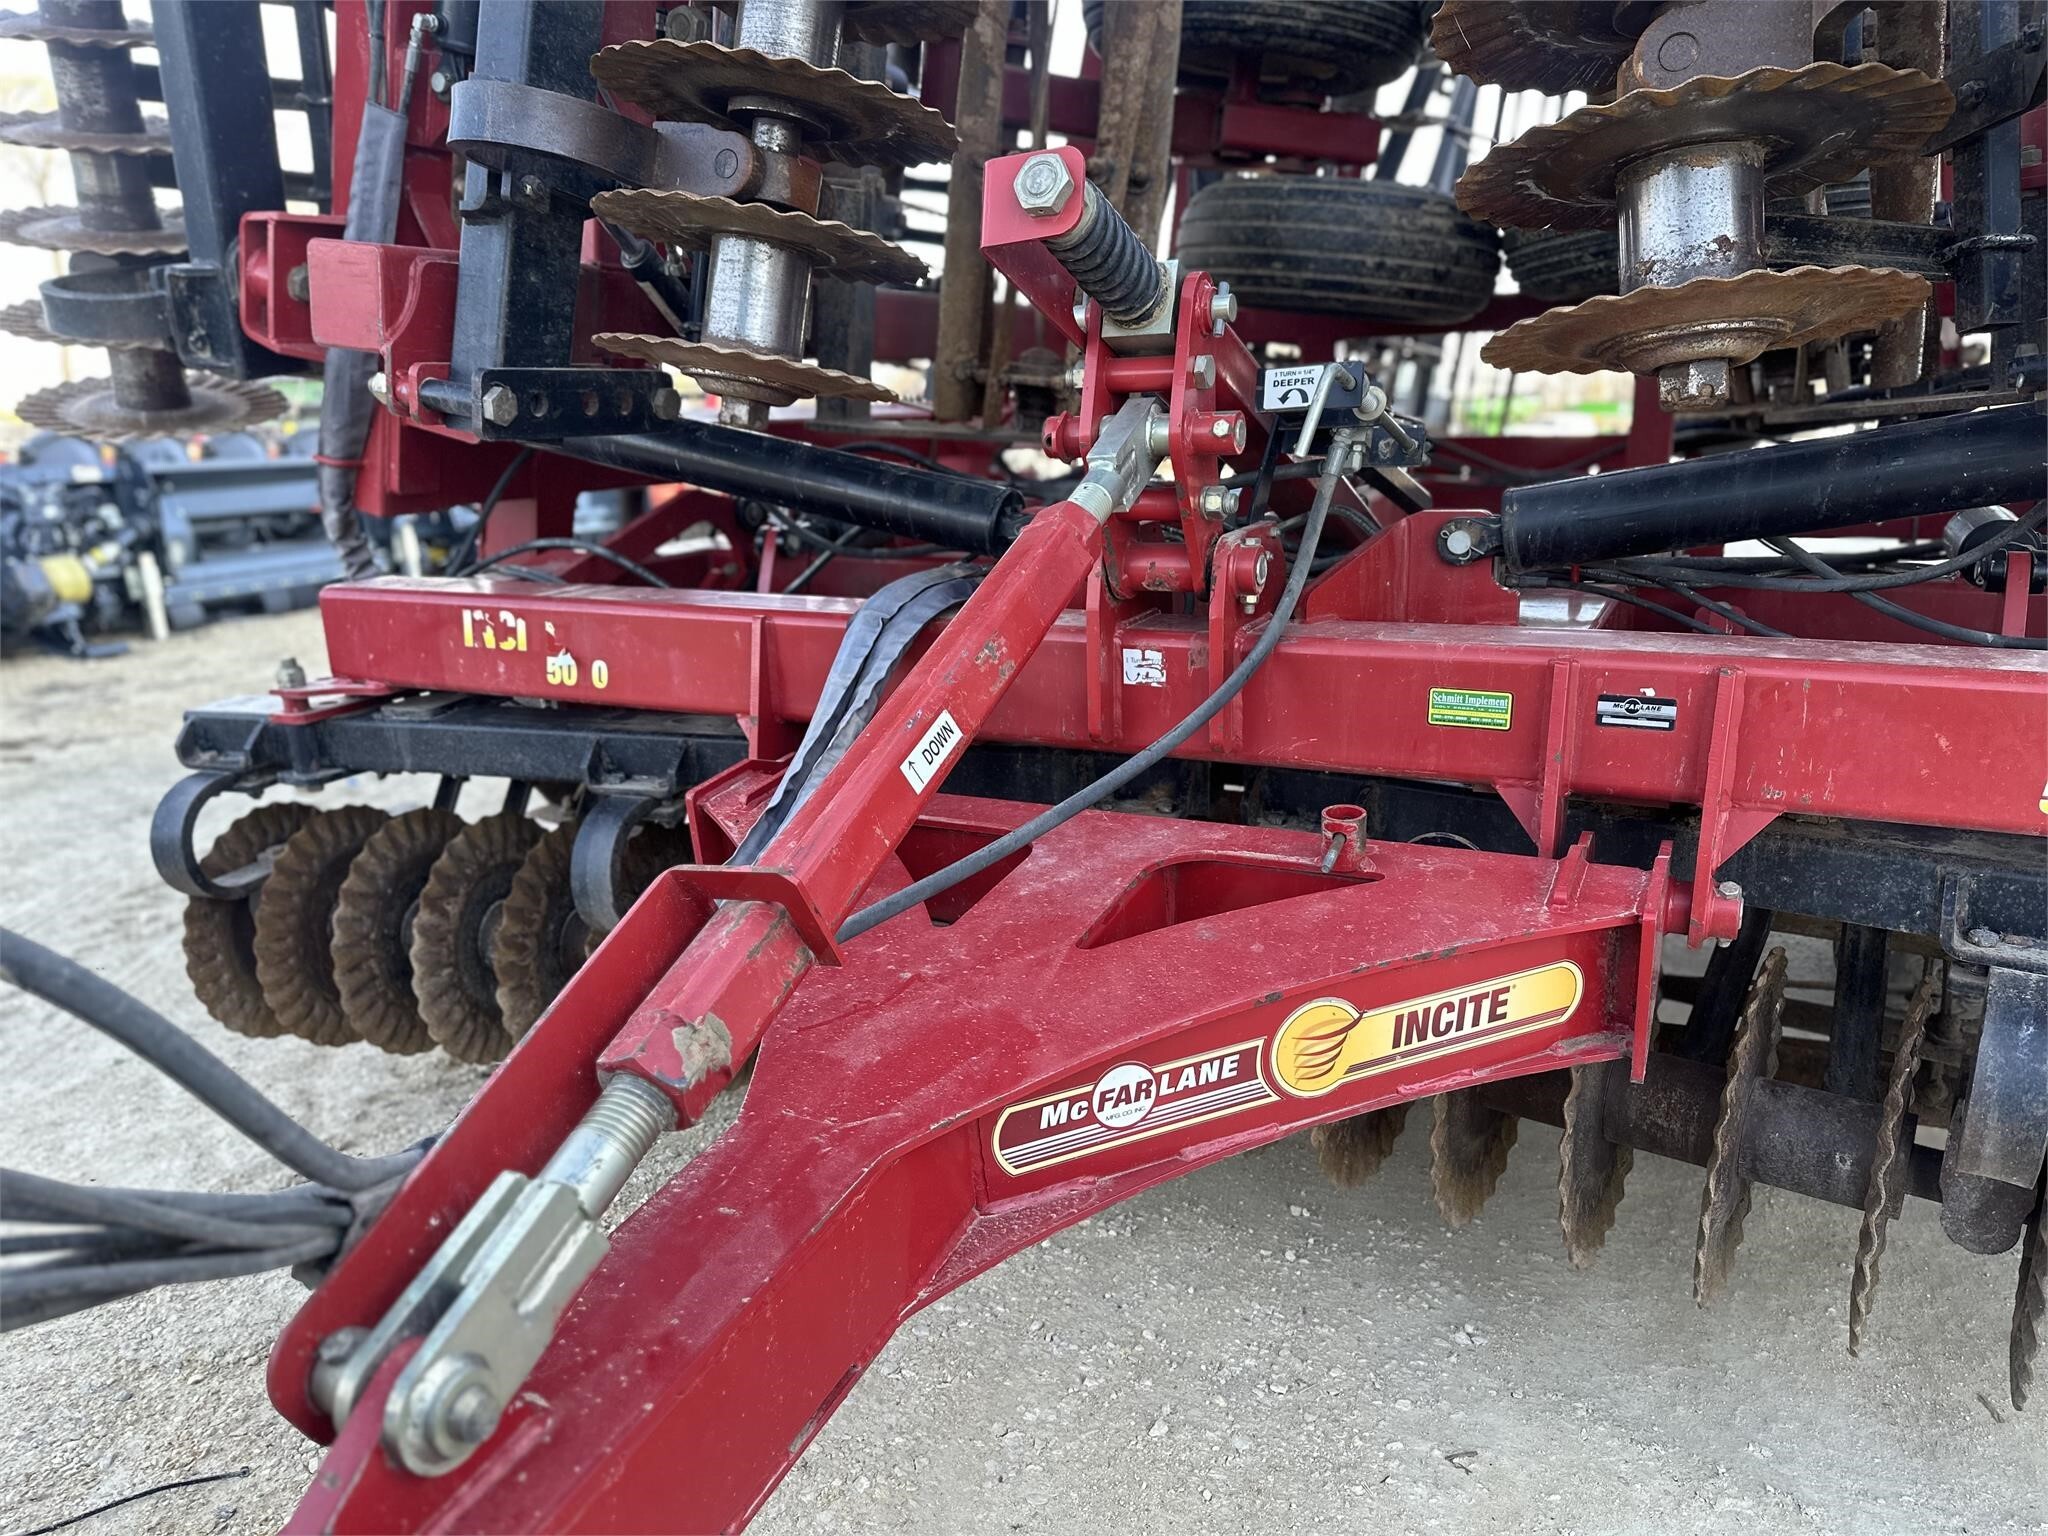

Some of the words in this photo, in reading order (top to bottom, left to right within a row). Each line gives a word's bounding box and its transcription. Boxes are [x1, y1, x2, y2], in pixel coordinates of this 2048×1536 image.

[1273, 377, 1315, 388] DEEPER
[1433, 692, 1463, 703] Schmitt
[1465, 695, 1508, 707] Implement
[921, 720, 955, 766] DOWN
[1391, 986, 1512, 1050] INCITE
